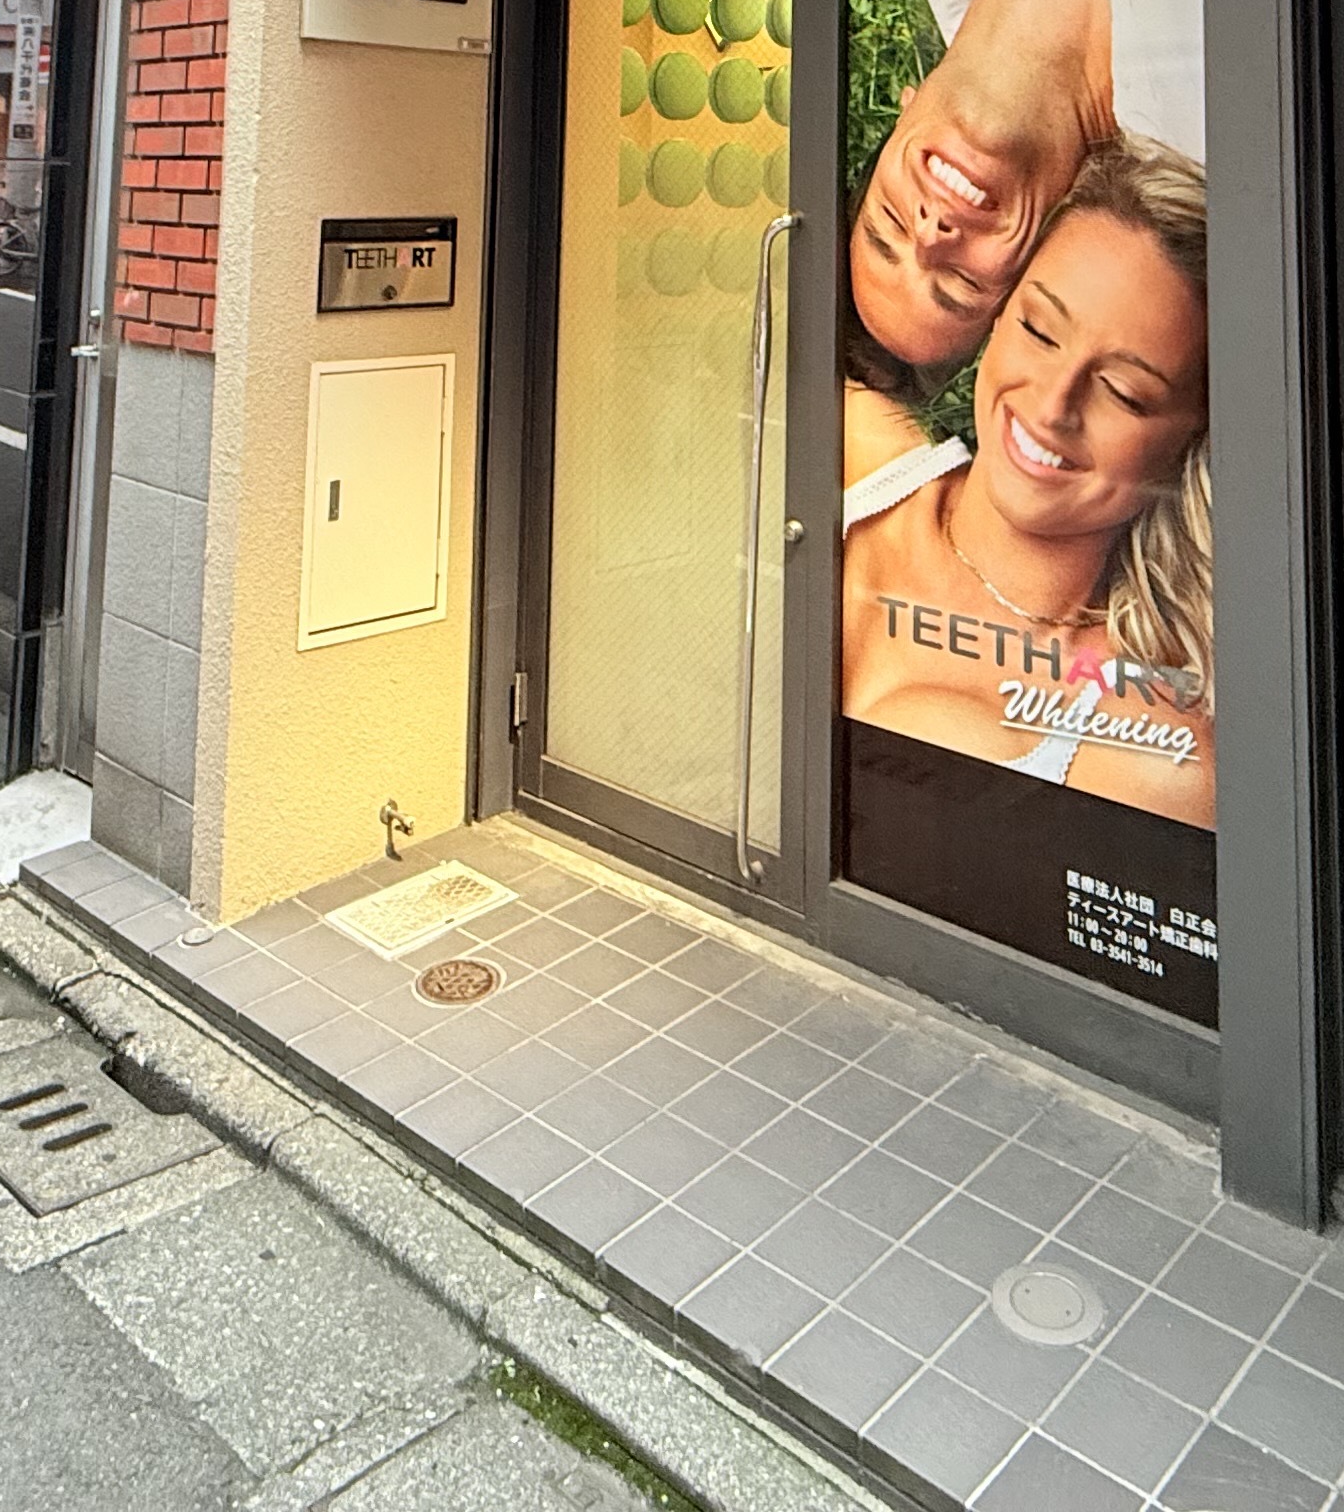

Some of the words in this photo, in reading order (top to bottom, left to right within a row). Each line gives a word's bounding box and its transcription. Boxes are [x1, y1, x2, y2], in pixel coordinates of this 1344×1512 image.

[344, 247, 436, 269] TEETHART
[998, 679, 1198, 765] Whitening
[1066, 869, 1155, 917] 医療法人社団
[1169, 907, 1217, 939] 白正会
[1067, 890, 1219, 961] ティースアート矯正歯科
[1067, 928, 1086, 948] TEL
